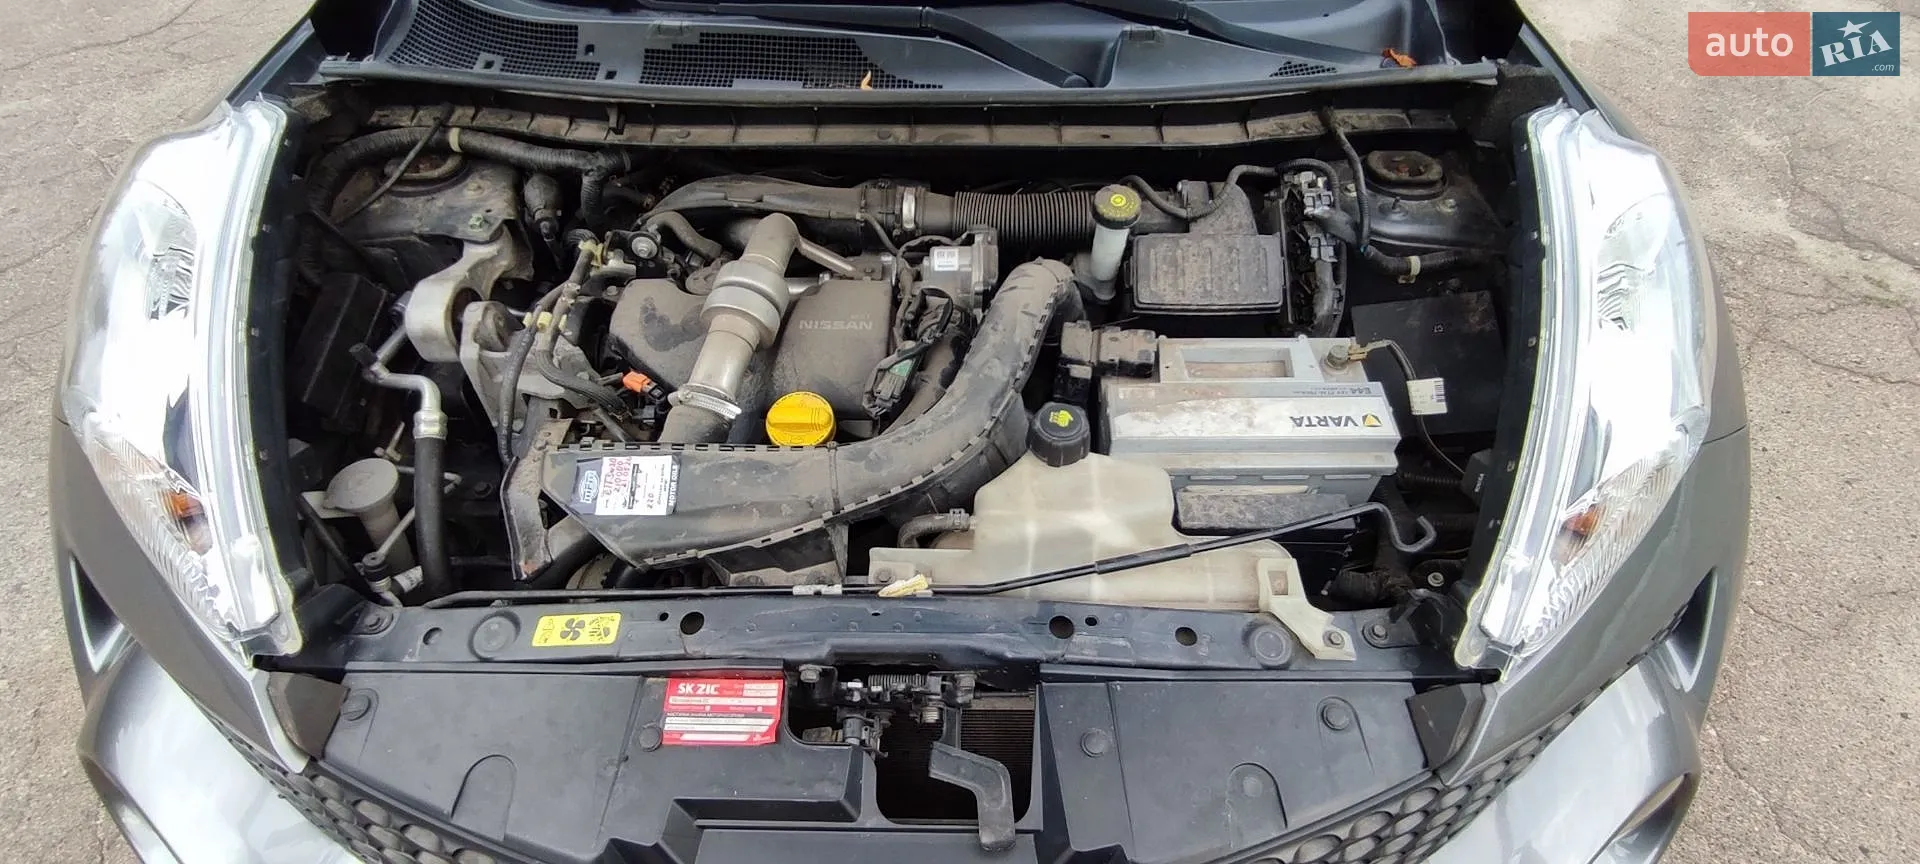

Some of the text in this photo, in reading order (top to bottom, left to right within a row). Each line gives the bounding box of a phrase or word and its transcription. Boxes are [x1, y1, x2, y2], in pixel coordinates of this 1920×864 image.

[799, 320, 873, 330] NISSAN
[1289, 415, 1358, 427] VARTA
[668, 481, 677, 507] MOTOR
[677, 683, 694, 695] SK
[695, 683, 720, 695] ZIC
